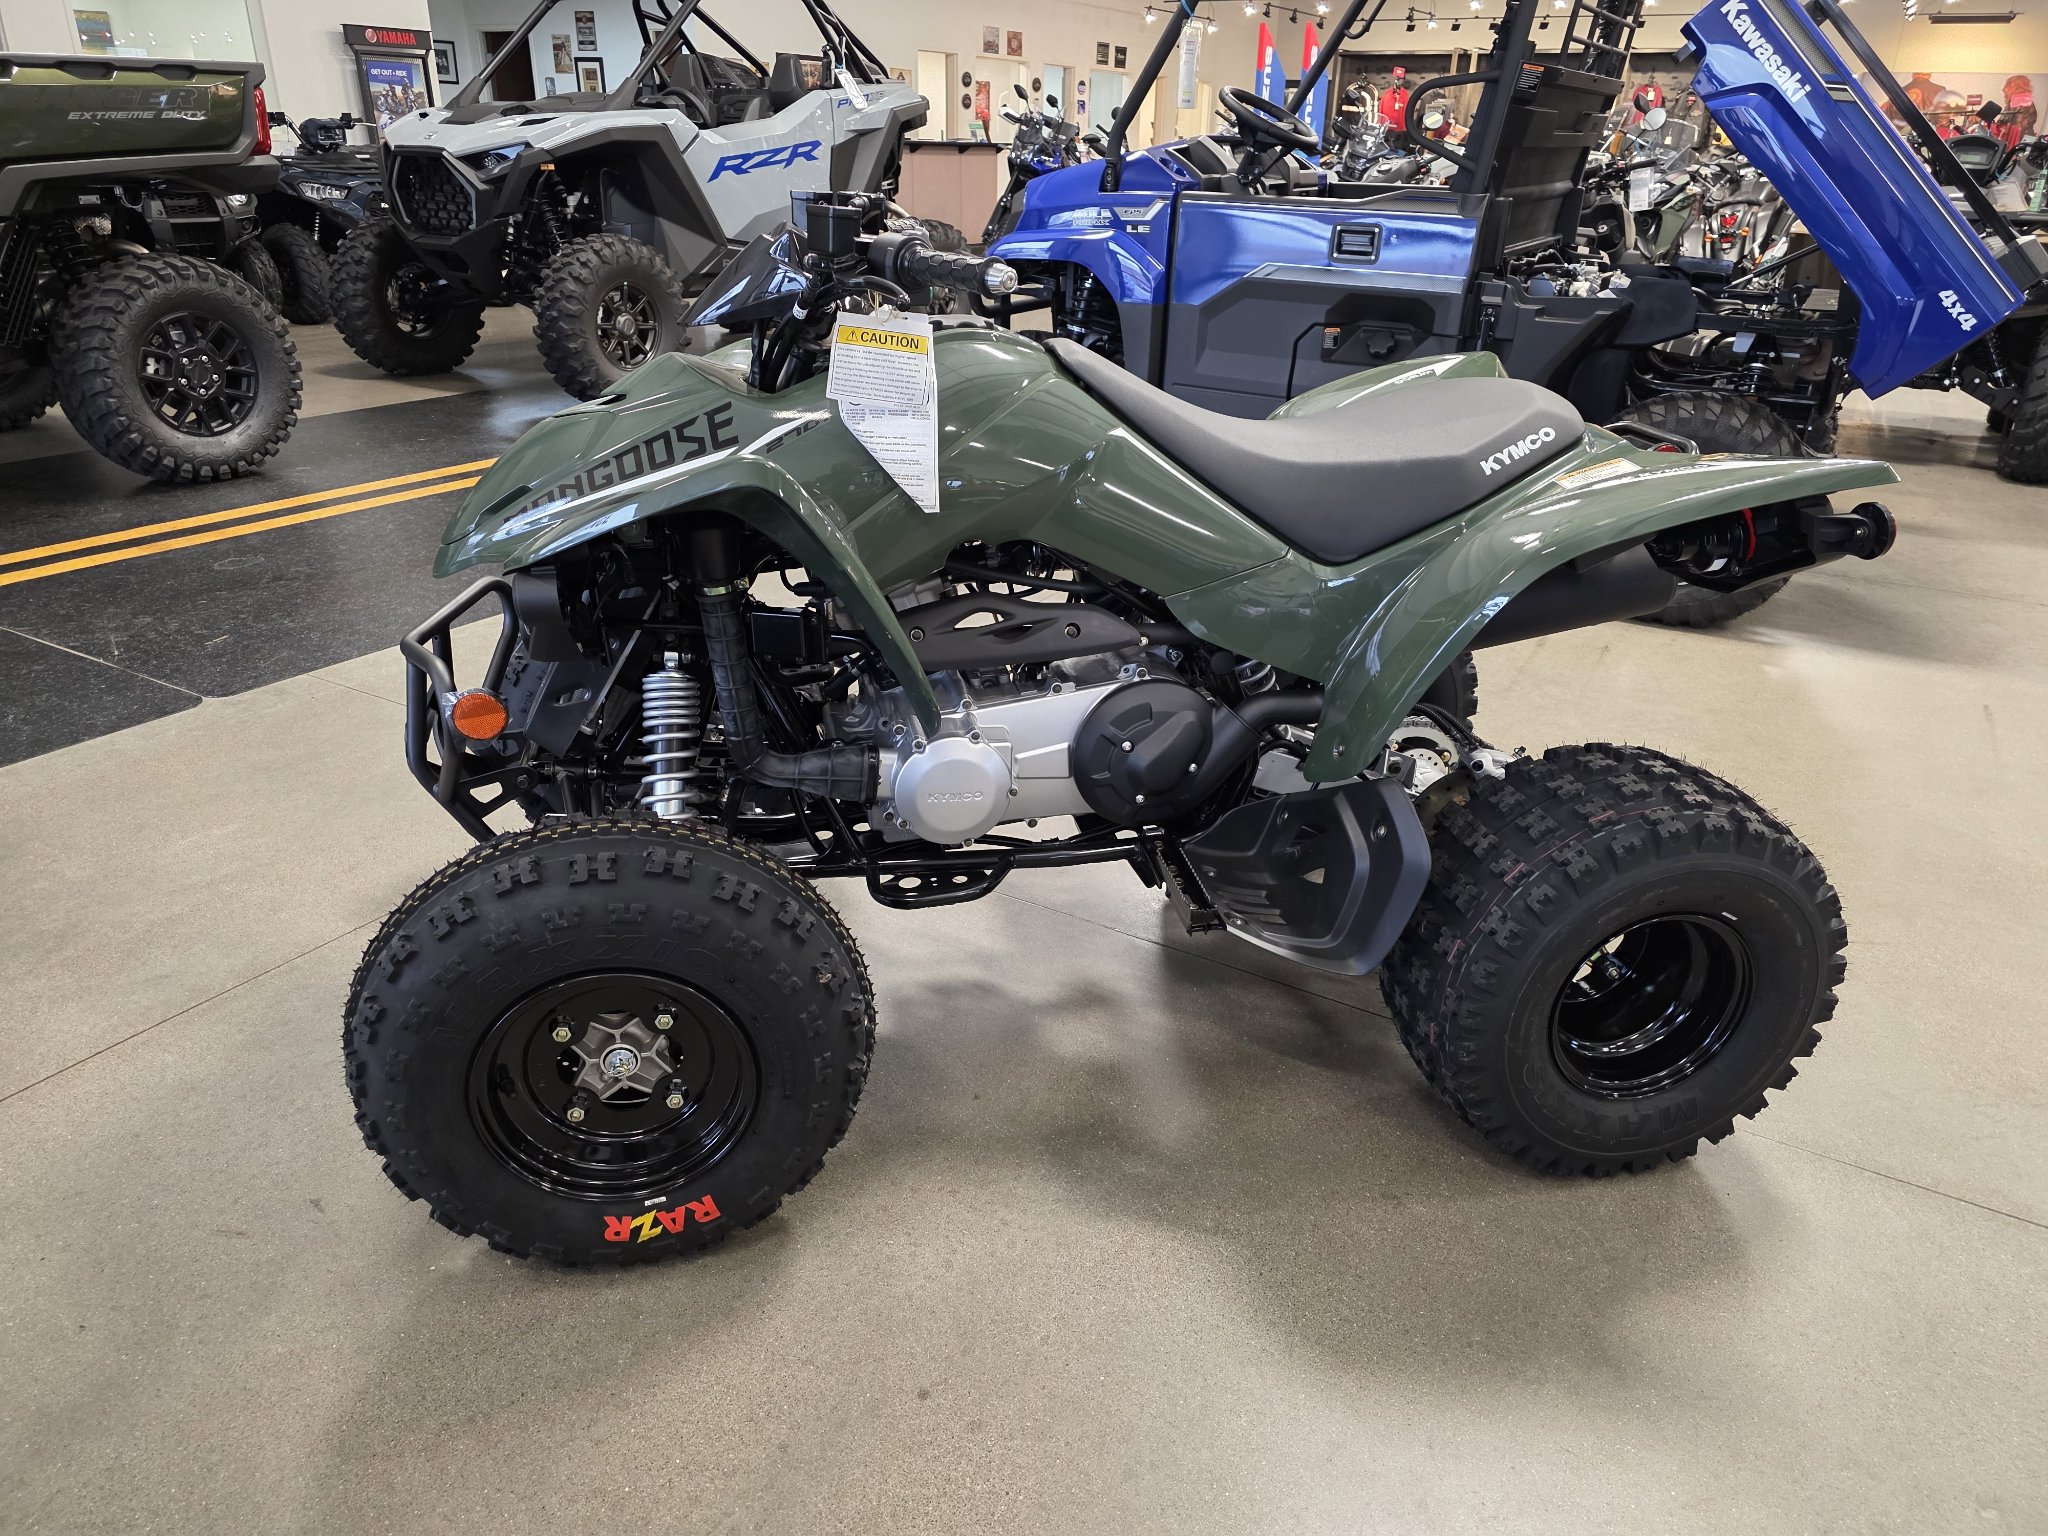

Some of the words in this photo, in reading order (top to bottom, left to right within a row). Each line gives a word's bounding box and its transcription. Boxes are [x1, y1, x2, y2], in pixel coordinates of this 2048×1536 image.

[376, 31, 416, 45] YAMAHA
[1720, 0, 1812, 103] Kawasaki
[67, 111, 154, 120] EXTREME
[161, 110, 208, 120] DUTY
[707, 140, 823, 183] RZR
[1126, 225, 1151, 233] LE
[1938, 289, 1978, 332] 4x4
[860, 331, 919, 350] CAUTION
[1480, 427, 1556, 476] KYMCO
[927, 791, 984, 803] KYMCO
[603, 1194, 721, 1244] RAZR
